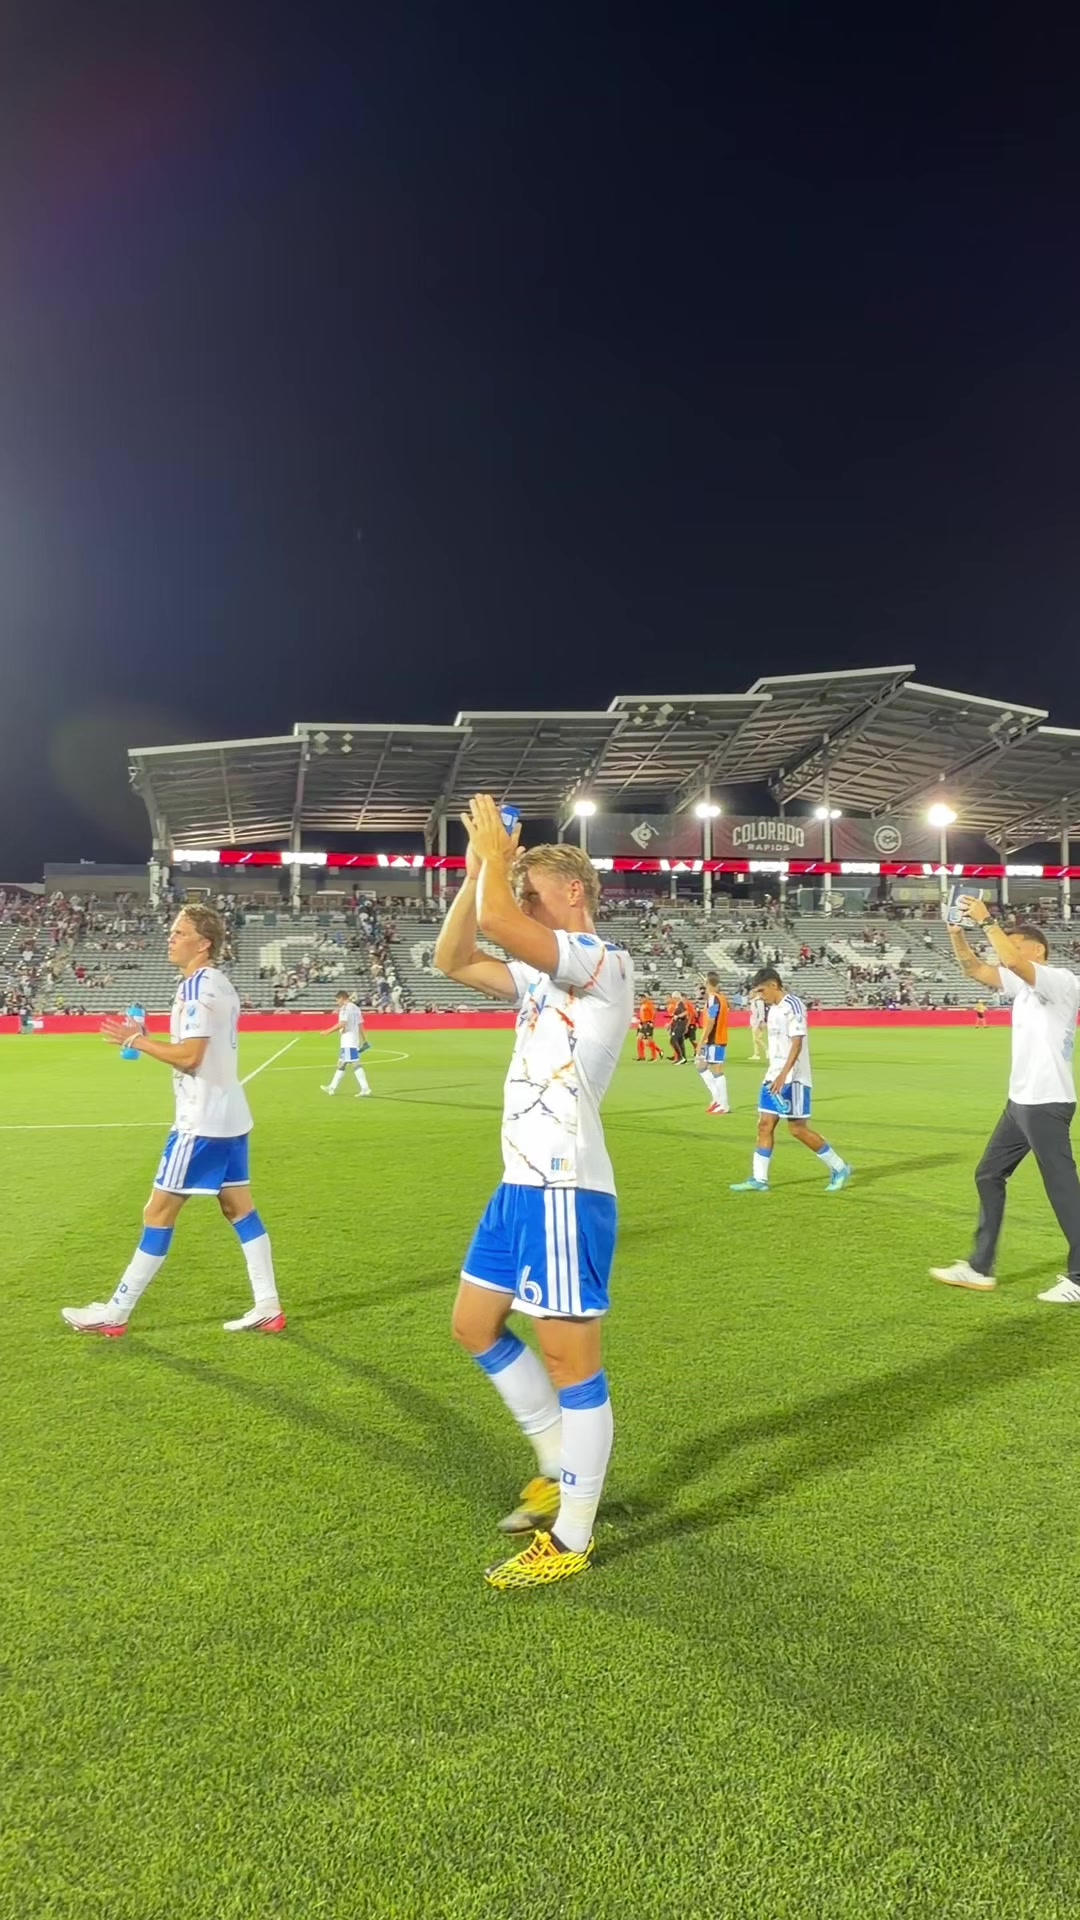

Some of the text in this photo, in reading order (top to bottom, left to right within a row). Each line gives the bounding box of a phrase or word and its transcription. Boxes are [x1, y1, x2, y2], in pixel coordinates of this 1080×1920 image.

[732, 821, 804, 847] COLORADO
[747, 843, 791, 852] RAPIDS
[519, 1264, 543, 1305] 6
